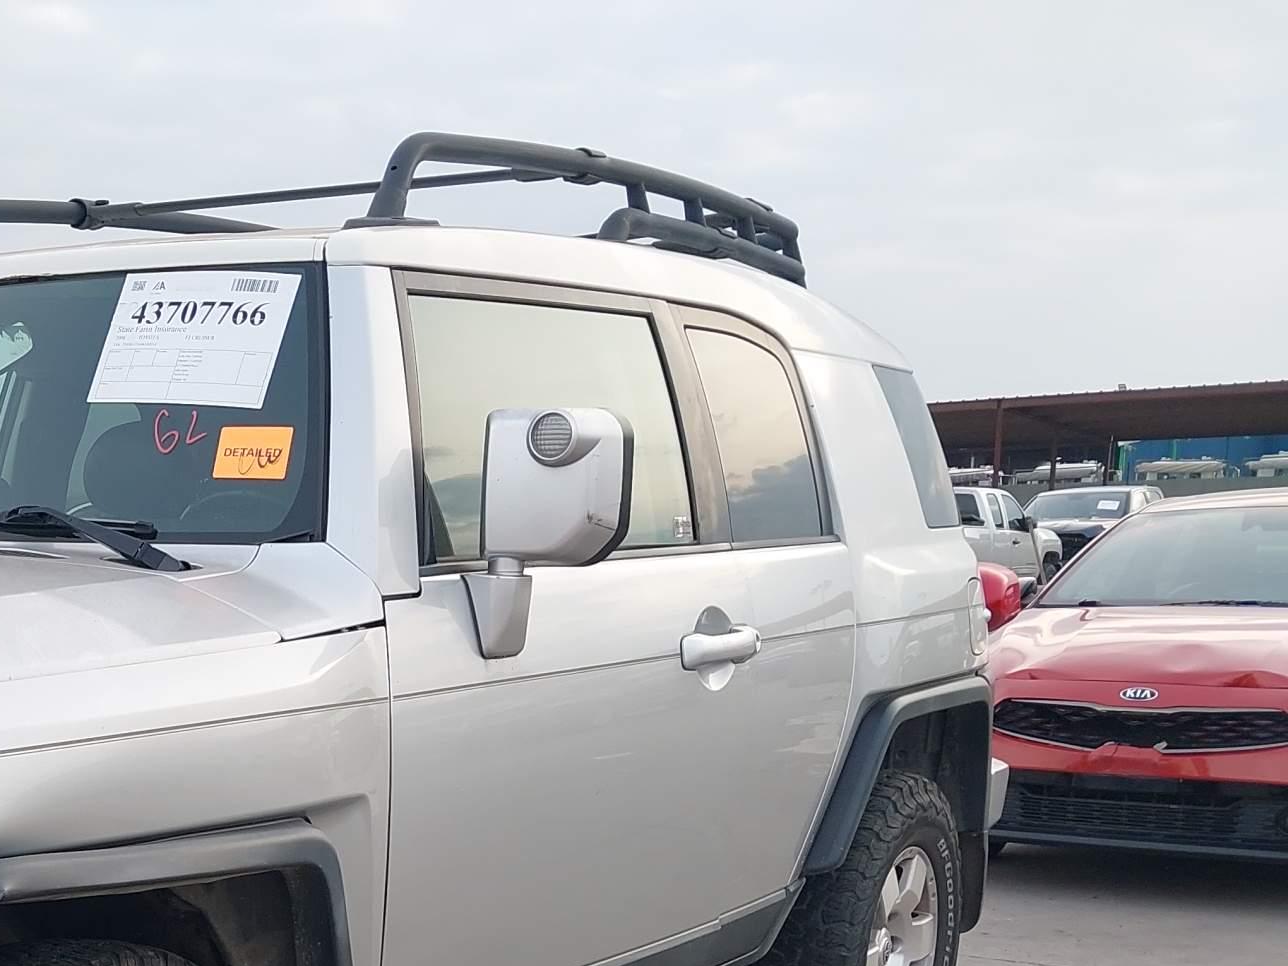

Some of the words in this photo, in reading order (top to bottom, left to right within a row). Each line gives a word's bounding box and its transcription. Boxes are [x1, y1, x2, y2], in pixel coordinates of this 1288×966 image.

[131, 300, 270, 326] 43707766
[223, 447, 283, 458] DETAILED
[1125, 689, 1151, 698] KIA
